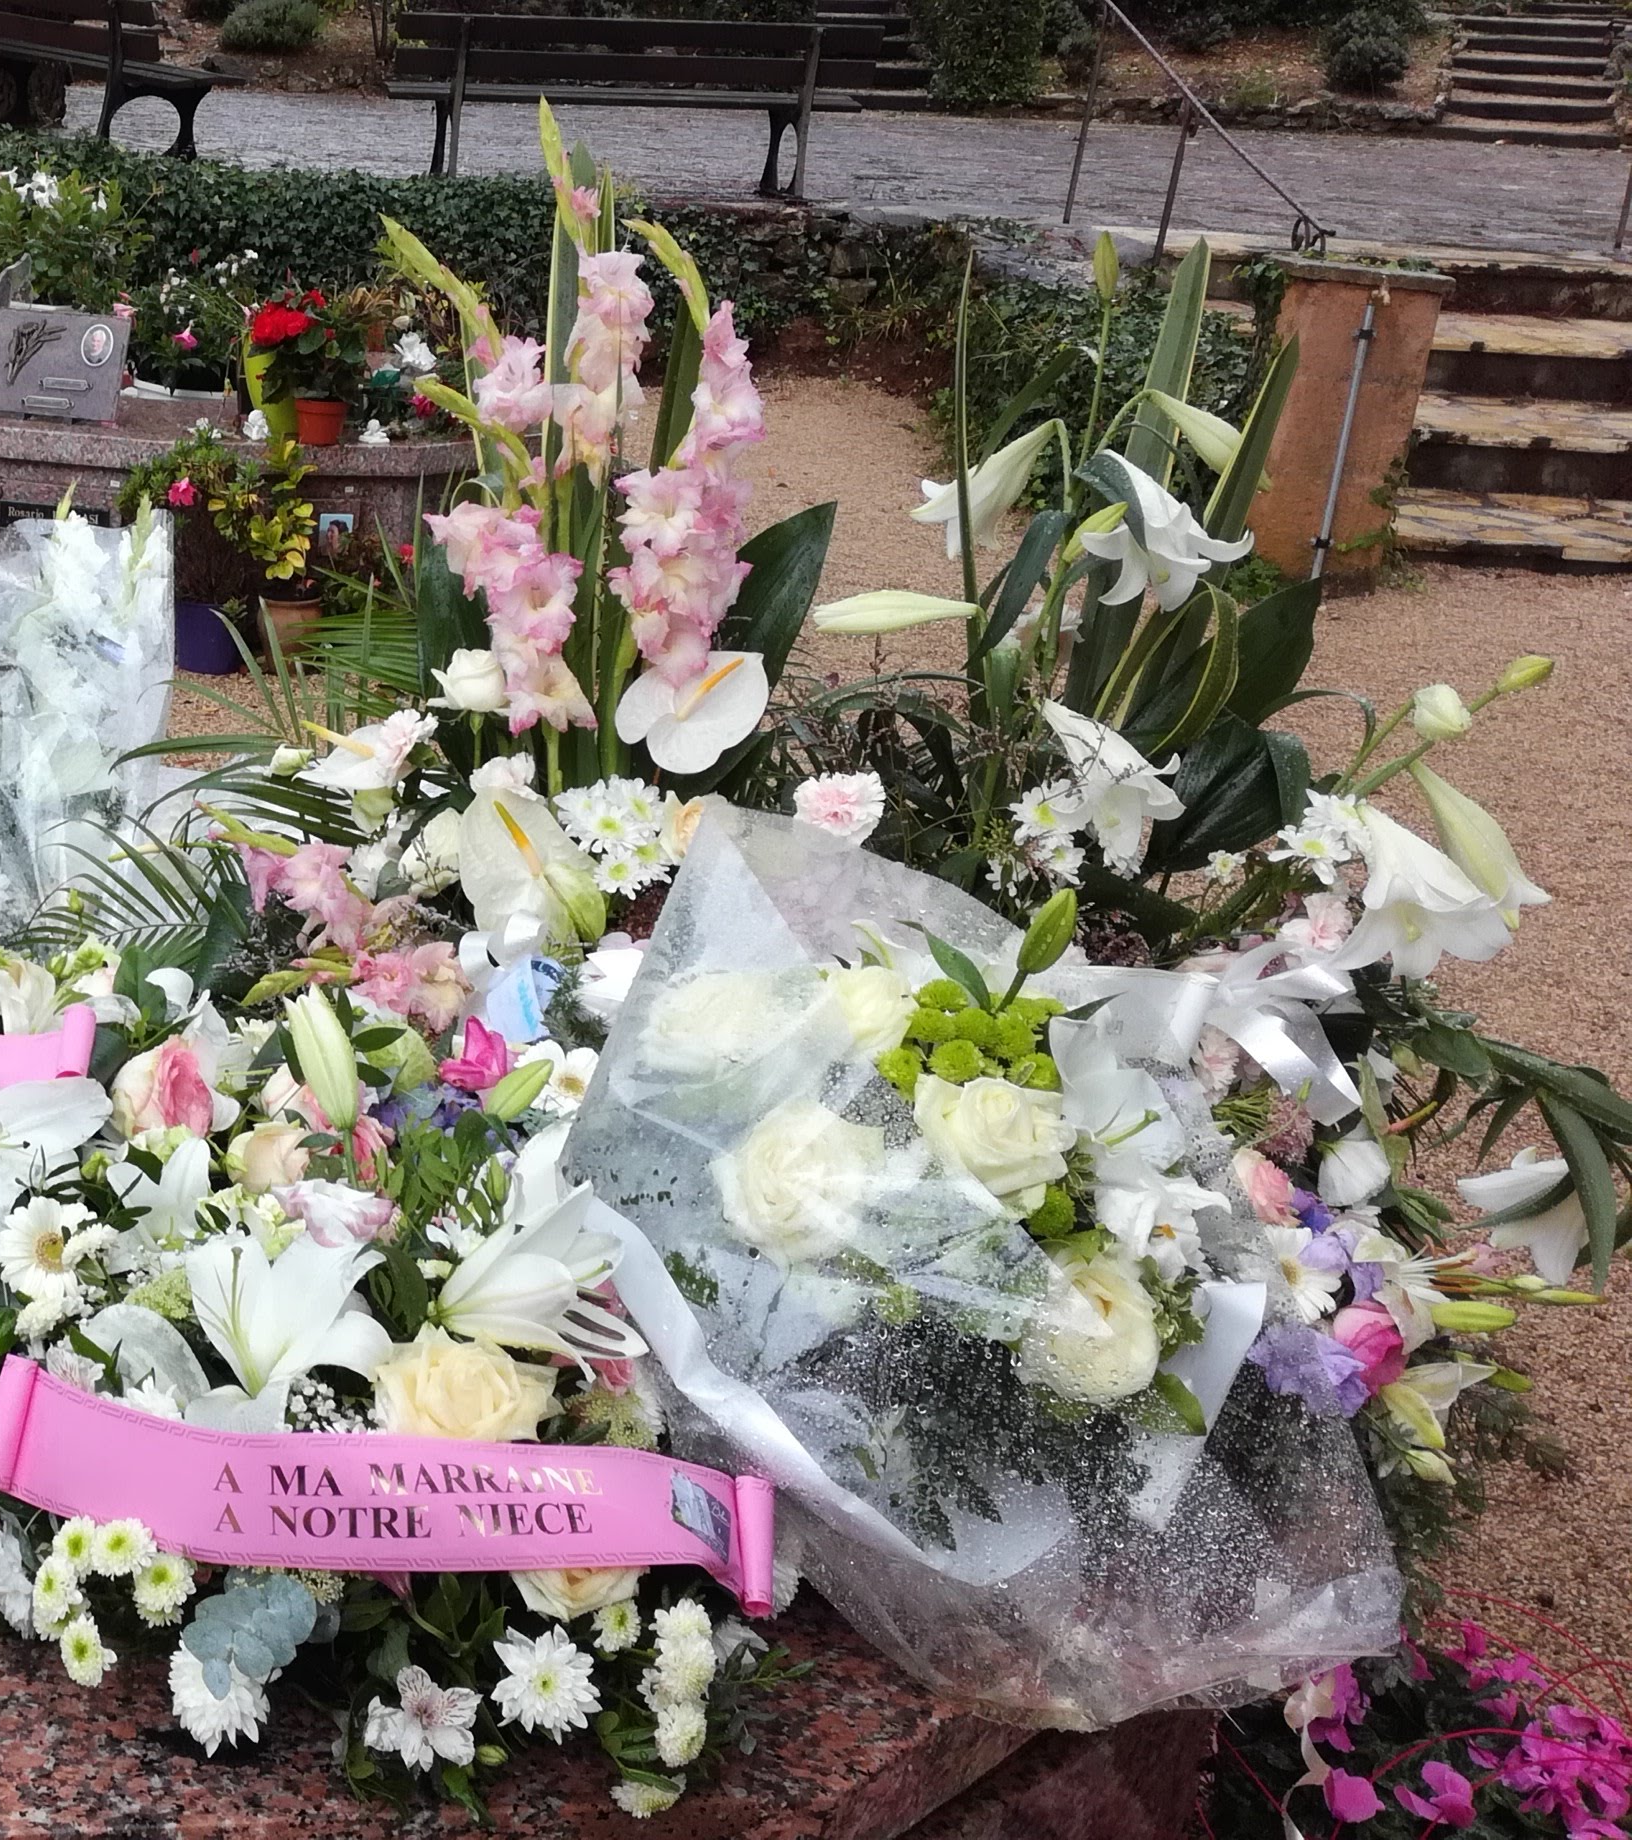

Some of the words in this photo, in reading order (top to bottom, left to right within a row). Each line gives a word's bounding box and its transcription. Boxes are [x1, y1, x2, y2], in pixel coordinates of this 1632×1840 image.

[214, 1462, 243, 1494] A
[268, 1464, 344, 1496] MA
[368, 1463, 604, 1496] MARRAINE
[214, 1502, 244, 1534] A
[270, 1504, 432, 1539] NOTRE
[456, 1503, 593, 1537] NIECE
